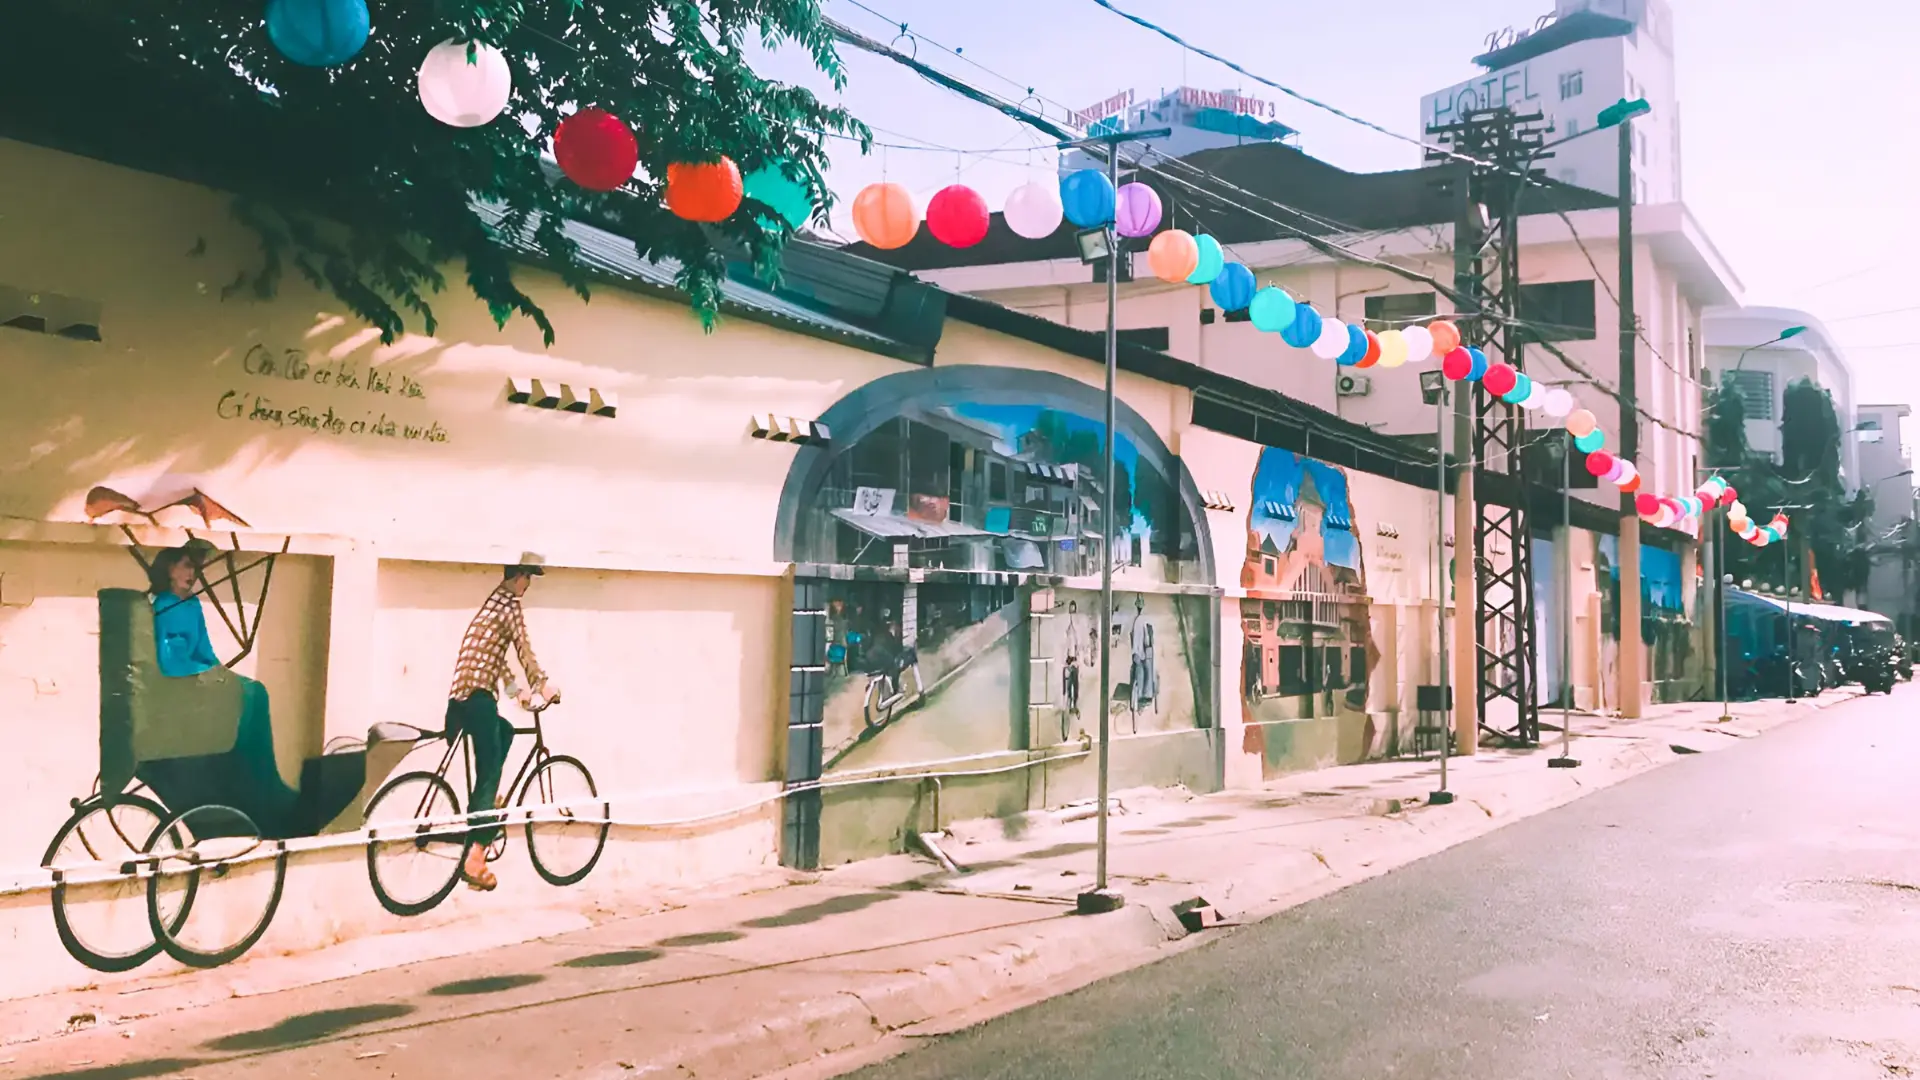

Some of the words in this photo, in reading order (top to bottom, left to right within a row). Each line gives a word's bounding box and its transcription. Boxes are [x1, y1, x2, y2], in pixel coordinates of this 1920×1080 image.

[1180, 86, 1227, 109] THANH
[1268, 102, 1276, 118] 3
[1434, 65, 1539, 127] HOTEL
